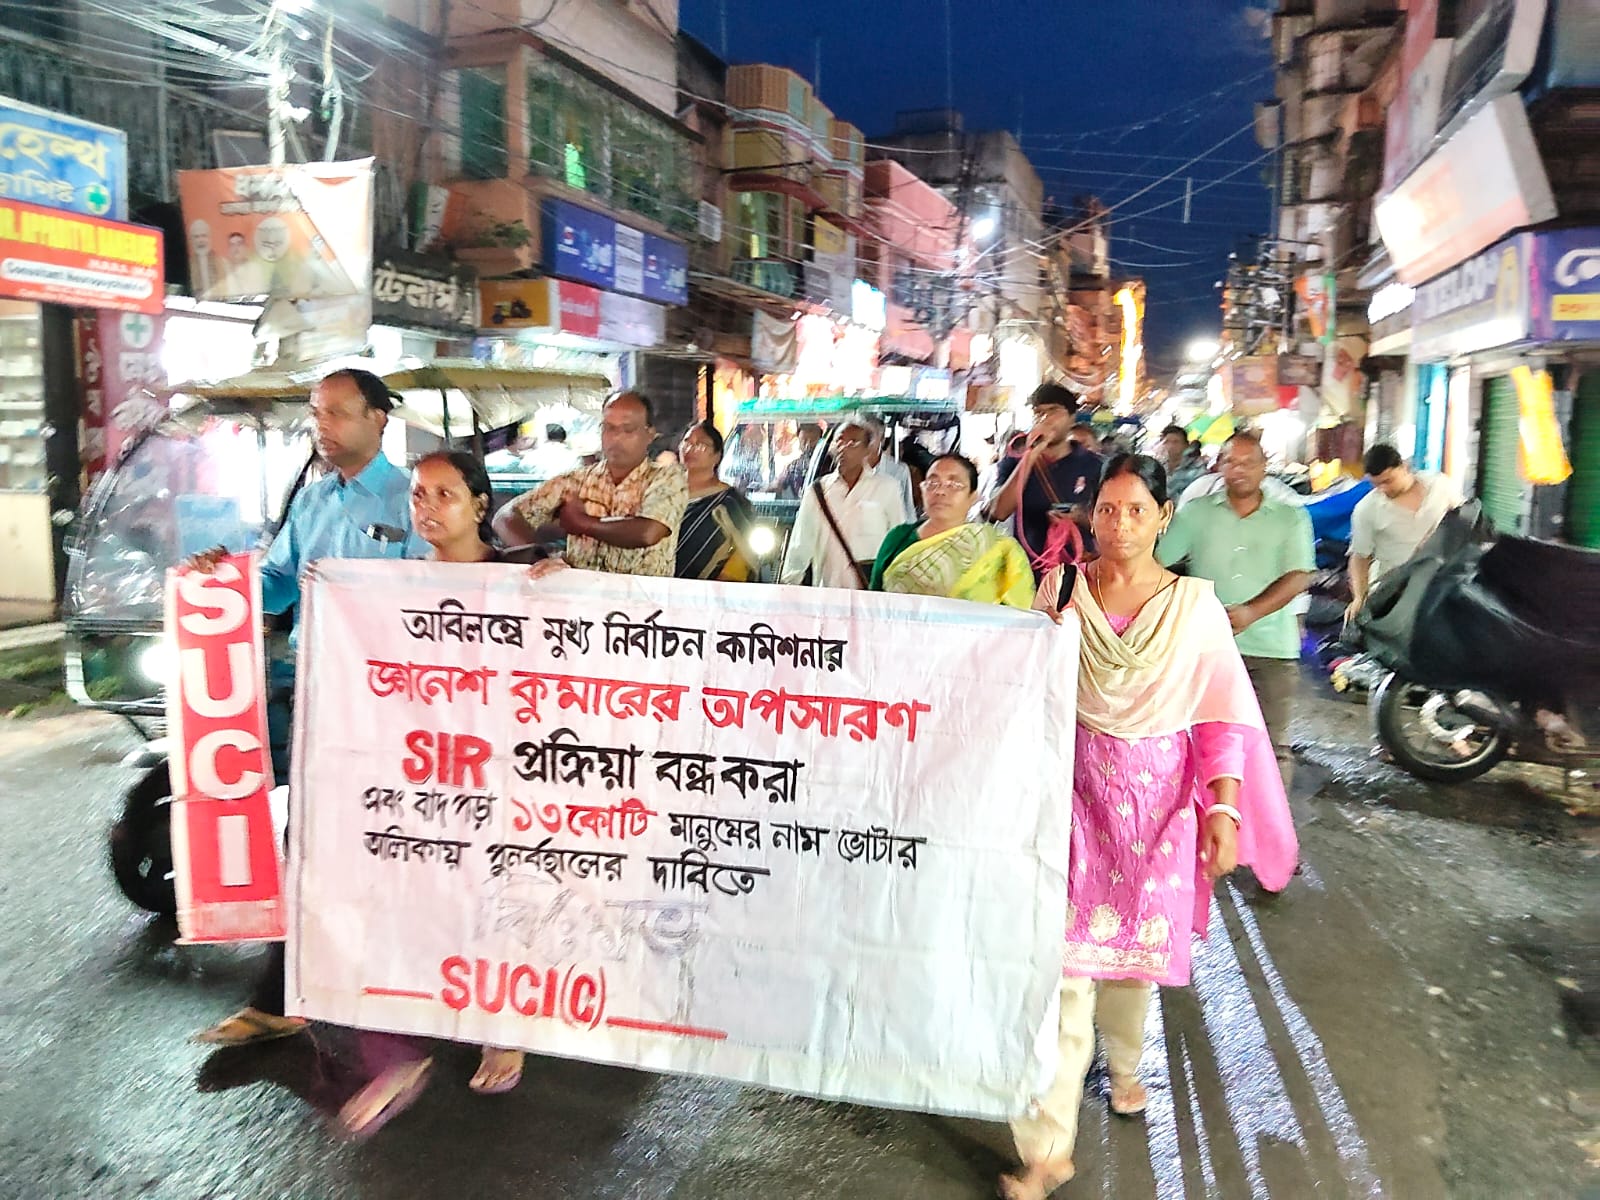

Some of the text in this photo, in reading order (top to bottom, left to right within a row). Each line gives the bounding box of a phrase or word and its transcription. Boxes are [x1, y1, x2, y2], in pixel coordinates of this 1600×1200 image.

[401, 598, 848, 672] অবিলম্বে মুখ্য নির্বাচন কমিশনার
[179, 562, 267, 888] SUCI
[367, 659, 931, 742] জ্ঞানেশ কুমারের অপসারণ
[402, 727, 805, 804] SIR প্রক্রিয়া বন্ধ করা
[647, 848, 771, 895] দাবিতে
[668, 812, 760, 852] মানুষের
[769, 820, 830, 857] নাম
[838, 825, 928, 870] ভোটার
[440, 954, 607, 1032] SUCI(C)
